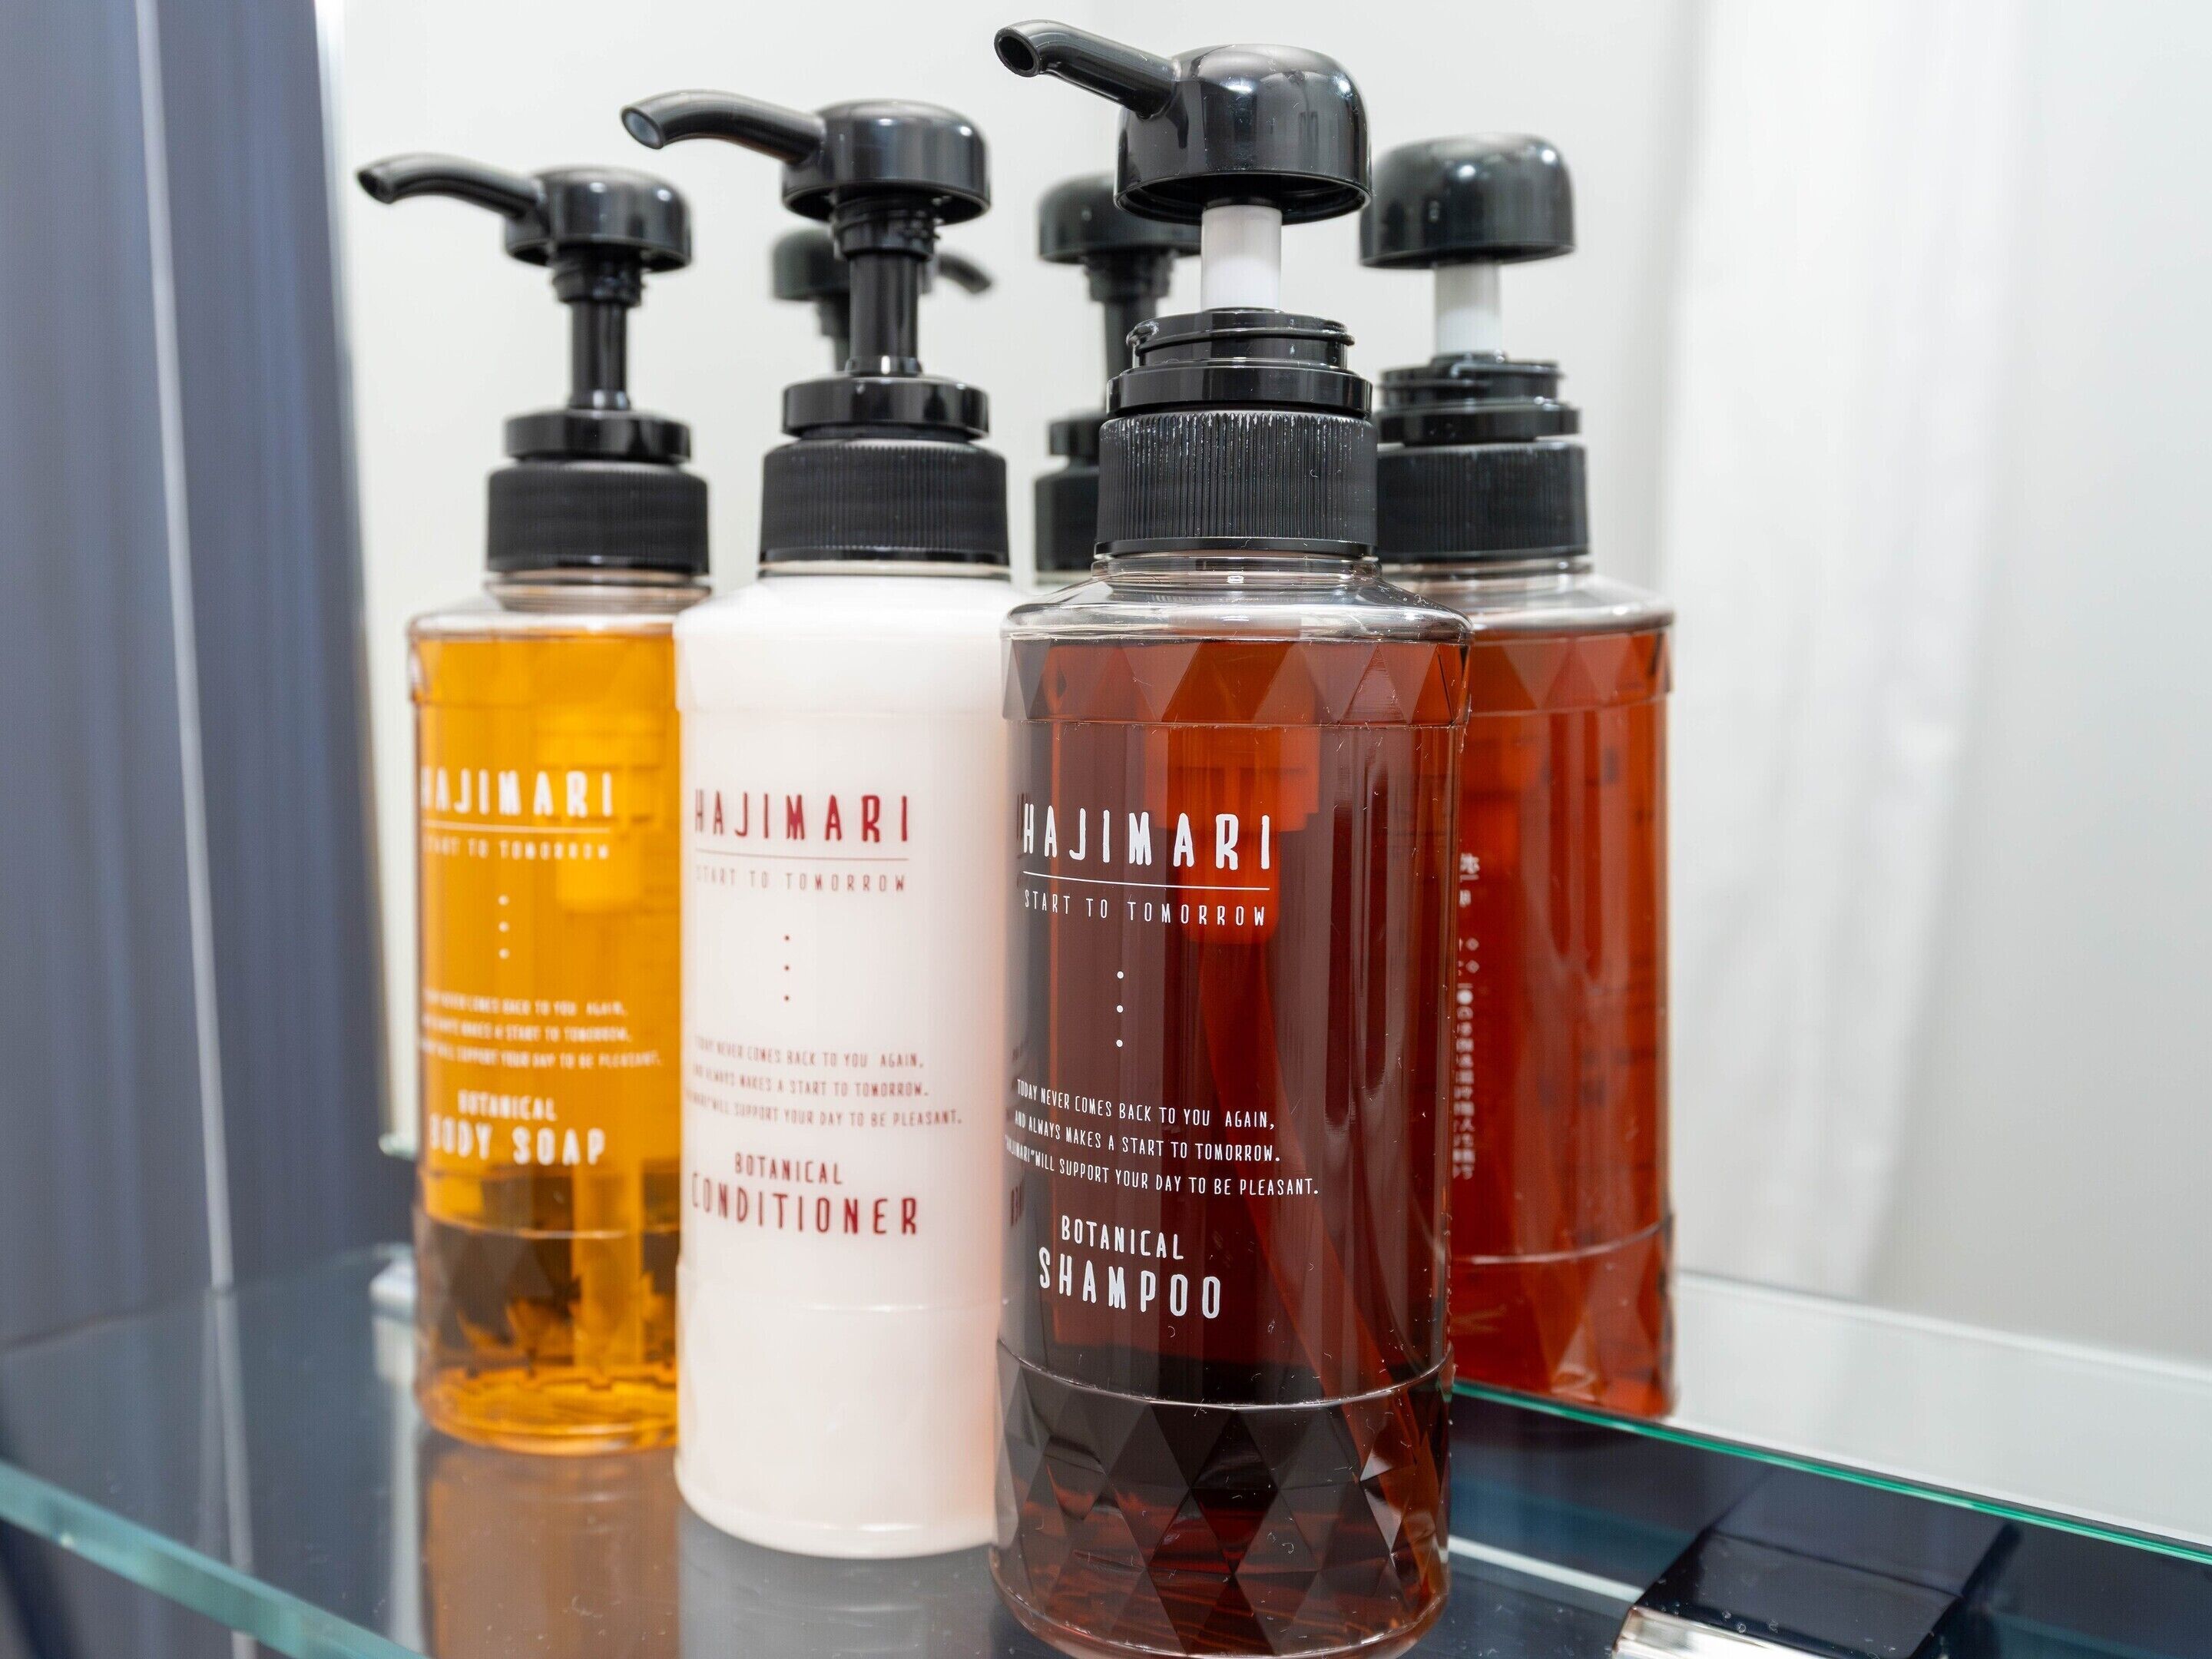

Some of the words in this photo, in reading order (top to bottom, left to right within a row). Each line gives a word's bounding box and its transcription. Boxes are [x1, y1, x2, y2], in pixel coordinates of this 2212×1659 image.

[695, 788, 908, 843] HAJIMARI
[1023, 803, 1270, 870] HAJIMARI
[696, 865, 735, 886] START
[750, 870, 768, 889] TO
[786, 873, 906, 892] TOMORROW
[1025, 889, 1070, 915] START
[1086, 898, 1108, 919] TO
[1127, 901, 1266, 926] TOMORROW
[747, 1045, 781, 1064] COMES
[786, 1049, 816, 1066] BACK
[823, 1051, 836, 1068] TO
[843, 1052, 867, 1068] YOU
[457, 1088, 558, 1121] BOTANICAL
[740, 1074, 771, 1092] MAKES
[777, 1078, 784, 1093] A
[790, 1080, 826, 1096] START
[834, 1081, 848, 1097] TO
[855, 1081, 929, 1097] TOMORROW.
[1017, 1078, 1038, 1101] TODAY
[1041, 1088, 1070, 1111] NEVER
[1075, 1095, 1112, 1117] COMES
[1119, 1102, 1151, 1122] BACK
[1159, 1107, 1176, 1124] TO
[1184, 1108, 1210, 1126] YOU
[1225, 1111, 1275, 1130] AGAIN,
[733, 1102, 779, 1124] SUPPORT
[784, 1108, 814, 1125] YOUR
[820, 1111, 842, 1127] DAY
[849, 1112, 864, 1128] TO
[871, 1112, 886, 1128] BE
[892, 1108, 962, 1128] PLEASANT.
[511, 1126, 605, 1166] SOAP
[1015, 1110, 1026, 1128] AND
[1028, 1116, 1061, 1140] ALWAYS
[1065, 1126, 1101, 1148] MAKES
[1108, 1134, 1114, 1151] A
[1122, 1136, 1164, 1158] START
[1171, 1141, 1187, 1159] TO
[1195, 1142, 1280, 1162] TOMORROW.
[733, 1152, 843, 1185] BOTANICAL
[1059, 1158, 1109, 1184] SUPPORT
[1115, 1169, 1148, 1190] YOUR
[1156, 1174, 1181, 1192] DAY
[1188, 1177, 1206, 1194] TO
[1214, 1178, 1232, 1195] BE
[1240, 1177, 1319, 1197] PLEASANT.
[691, 1172, 918, 1235] CONDITIONER
[1061, 1214, 1184, 1260] BOTANICAL
[1038, 1247, 1221, 1320] SHAMPOO
